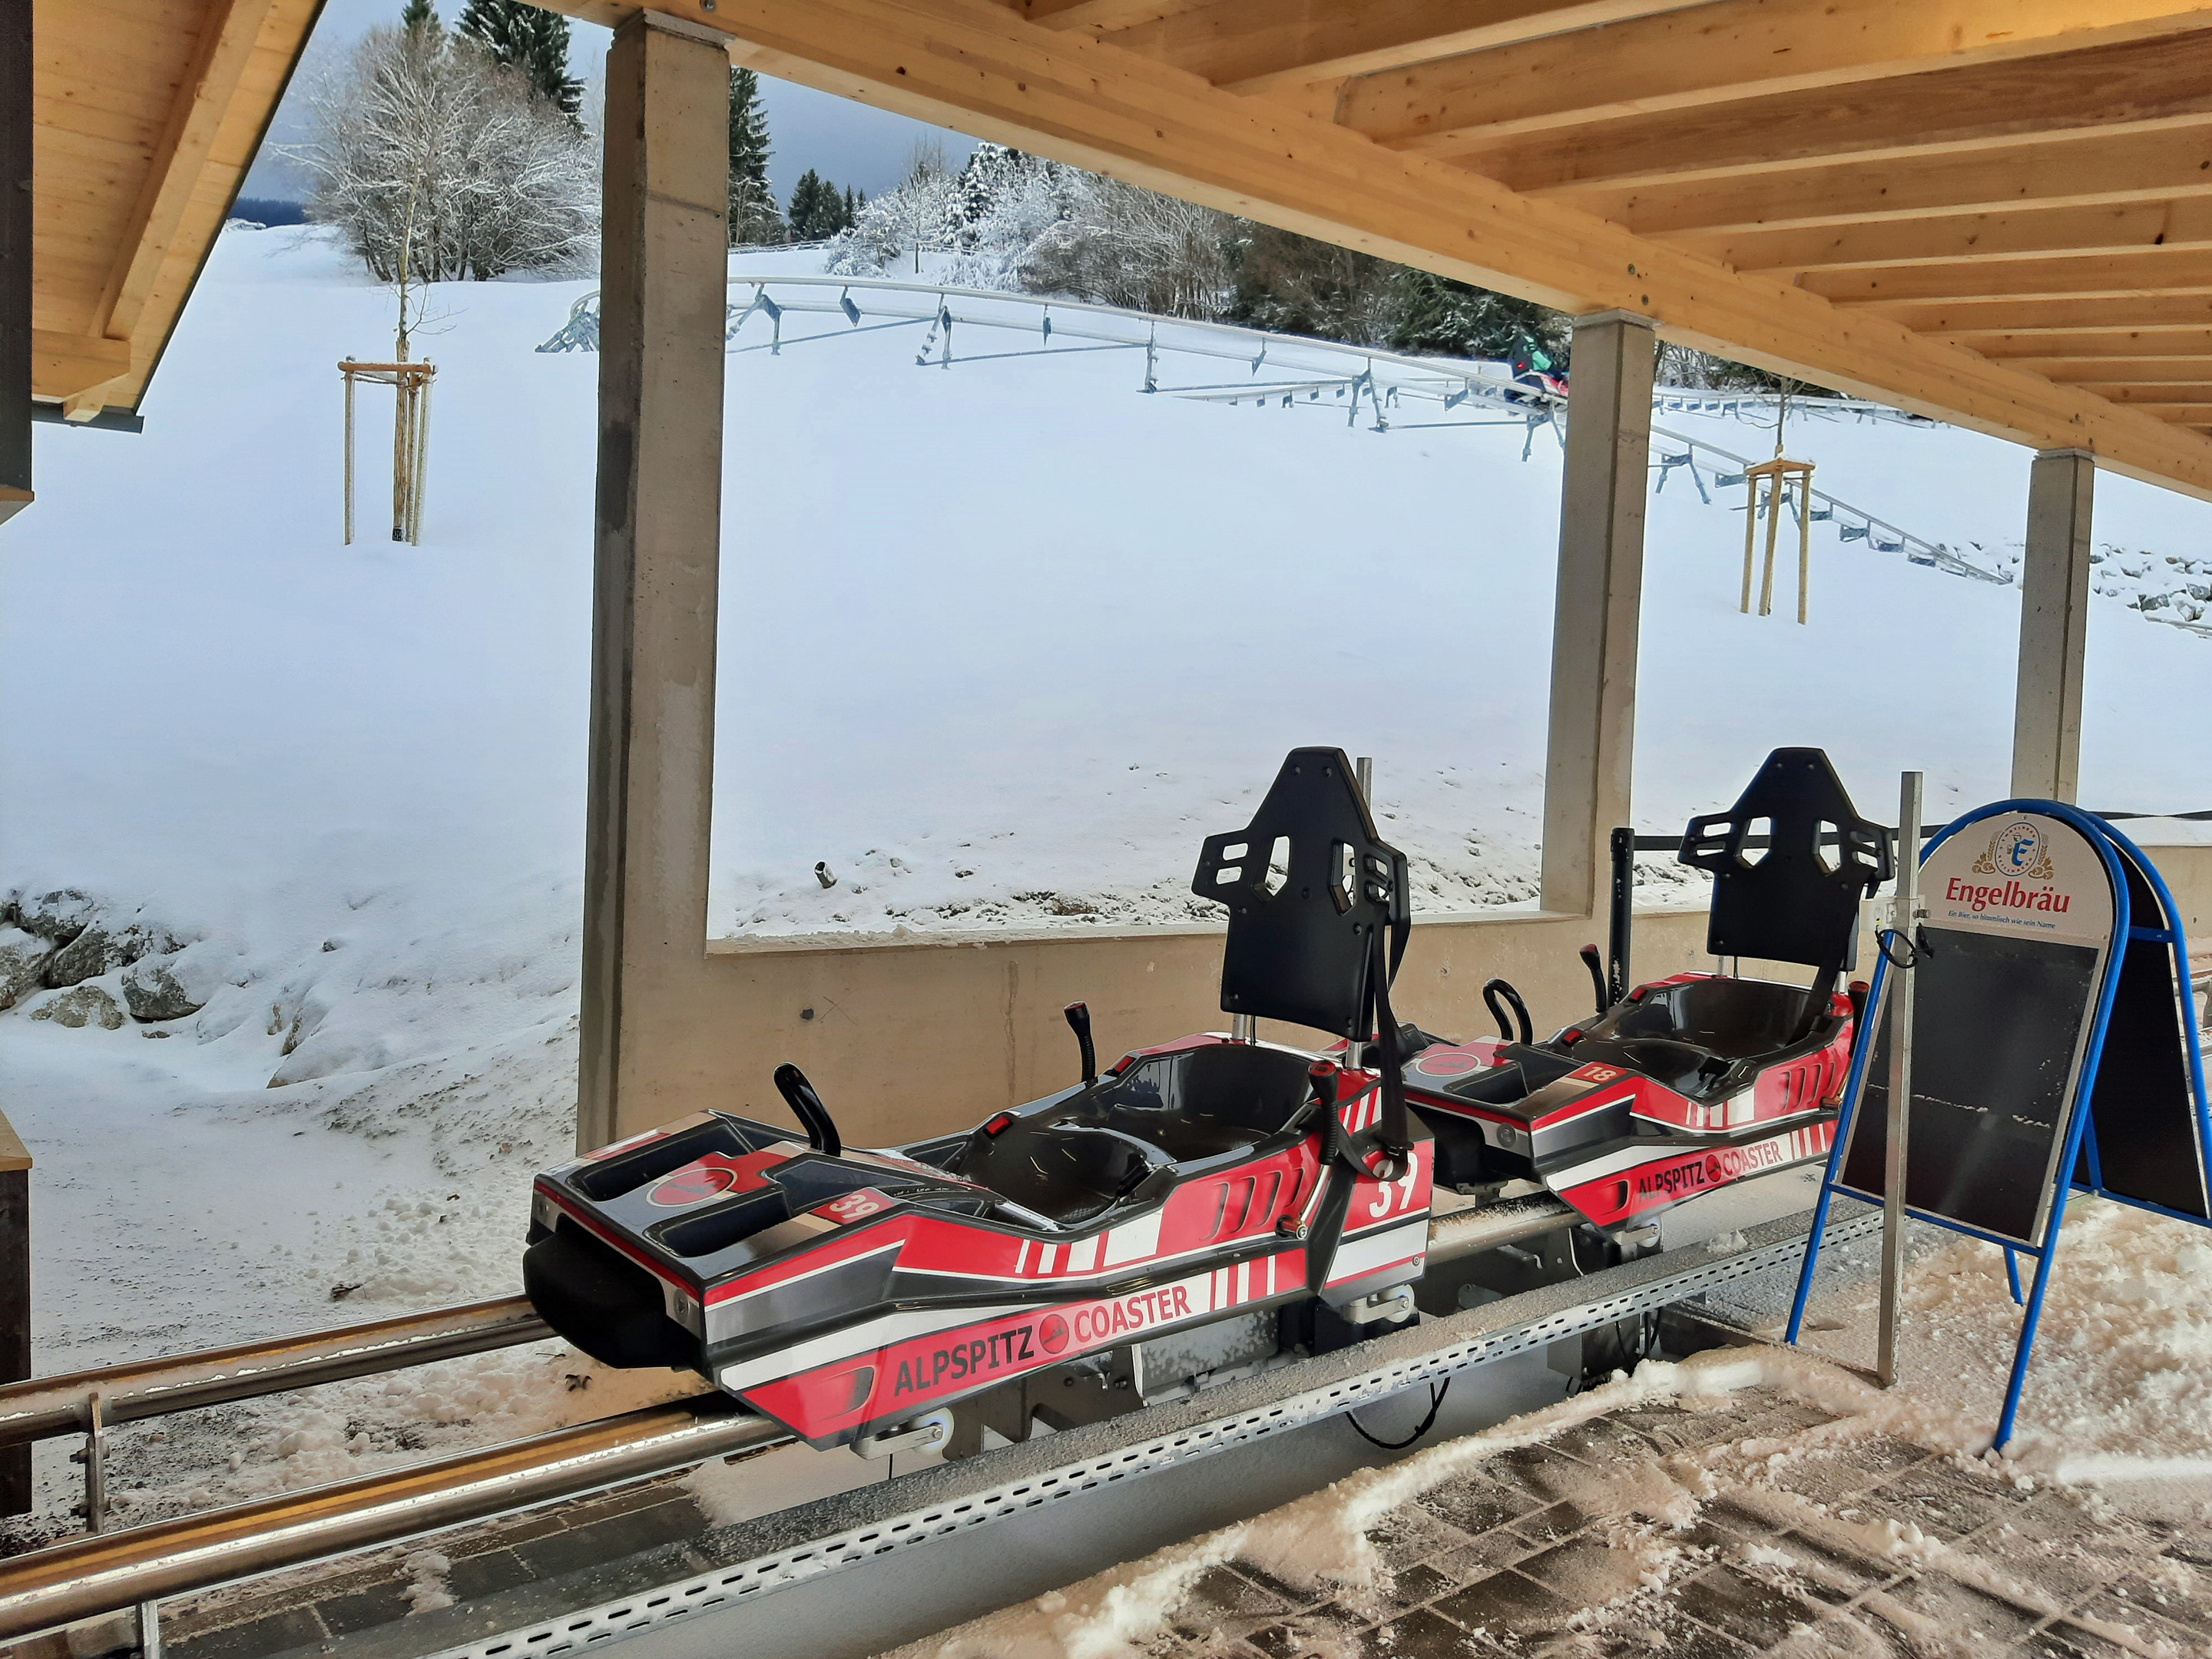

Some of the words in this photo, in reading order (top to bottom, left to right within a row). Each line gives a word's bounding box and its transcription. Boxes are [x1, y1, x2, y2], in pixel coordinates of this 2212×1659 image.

[1945, 876, 2071, 913] Engelbräu
[1958, 911, 1971, 919] Bier,
[1980, 913, 2010, 924] himmlisch
[2011, 917, 2022, 926] wie
[2024, 919, 2035, 927] sein
[2037, 920, 2056, 929] Name
[1582, 1066, 1618, 1081] 18
[1369, 1151, 1419, 1218] 39
[1638, 1161, 1706, 1203] ALPSPITZ
[1722, 1141, 1783, 1176] COASTER
[830, 1194, 879, 1219] 39
[894, 1324, 1035, 1396] ALPSPITZ
[1074, 1285, 1192, 1343] COASTER
